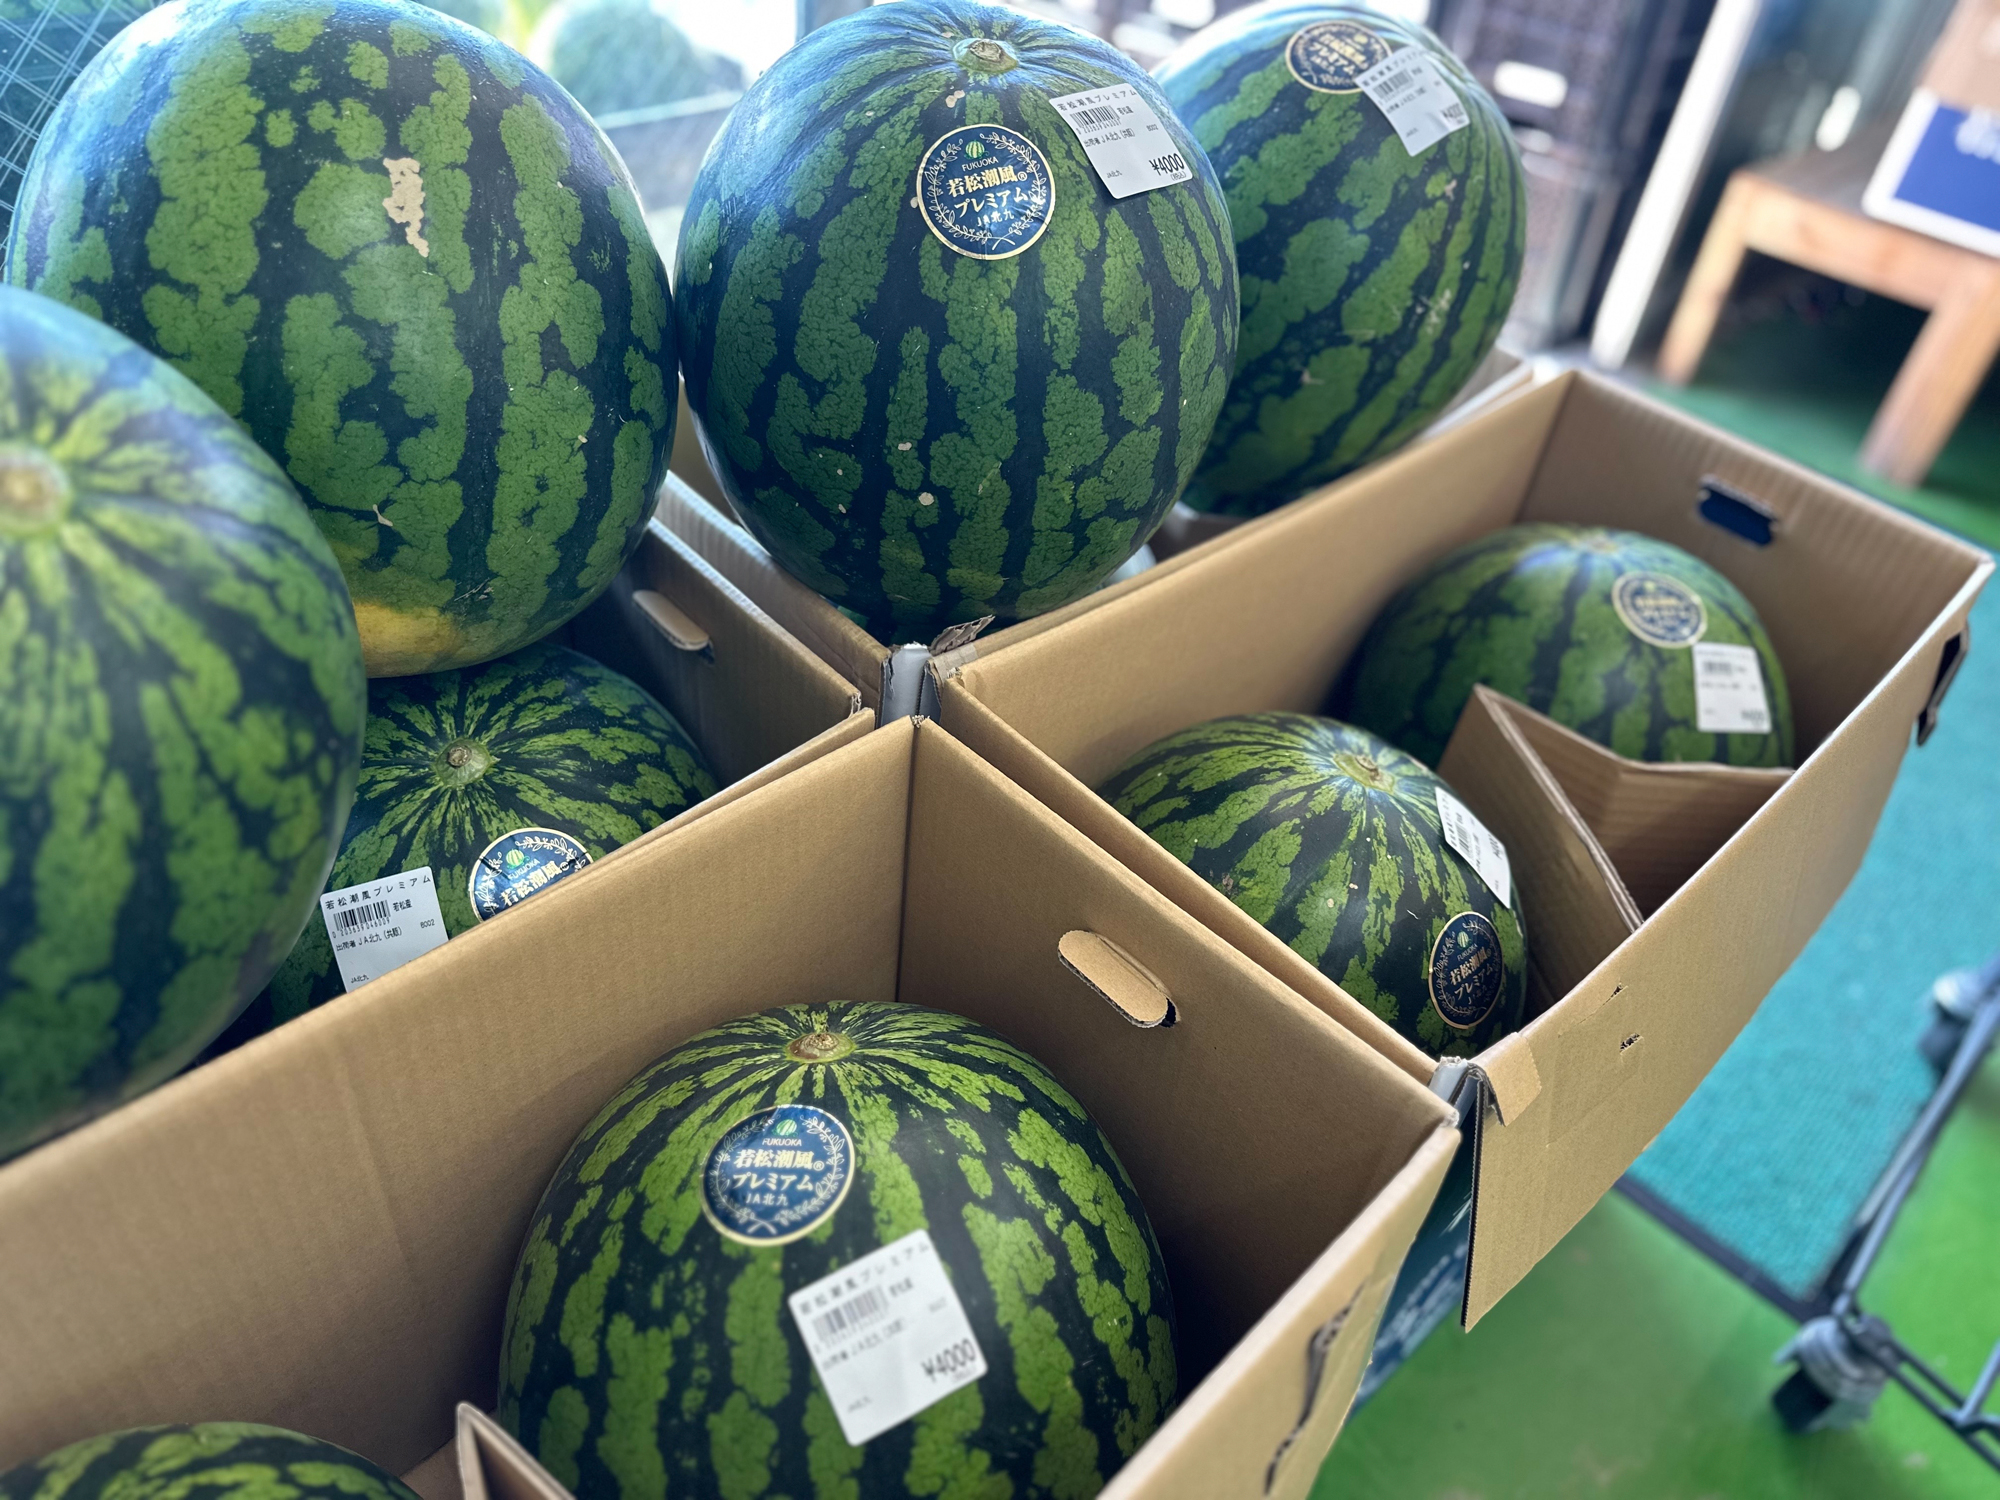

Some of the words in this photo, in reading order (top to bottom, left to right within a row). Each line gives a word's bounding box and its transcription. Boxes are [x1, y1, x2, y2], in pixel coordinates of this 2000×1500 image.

[961, 156, 999, 171] FUKUOKA
[1149, 153, 1184, 176] ¥4000
[954, 187, 1028, 218] プレミアム
[508, 858, 540, 880] FUKUOKA
[325, 875, 431, 910] 若松潮風プレミアム
[392, 899, 412, 912] 若松産
[1457, 943, 1478, 961] FUKUOKA
[1455, 963, 1493, 1000] プレミアム
[762, 1138, 802, 1147] FUKUOKA
[732, 1171, 814, 1191] プレミアム
[746, 1193, 788, 1206] JA北九
[922, 1337, 976, 1382] ¥4000
